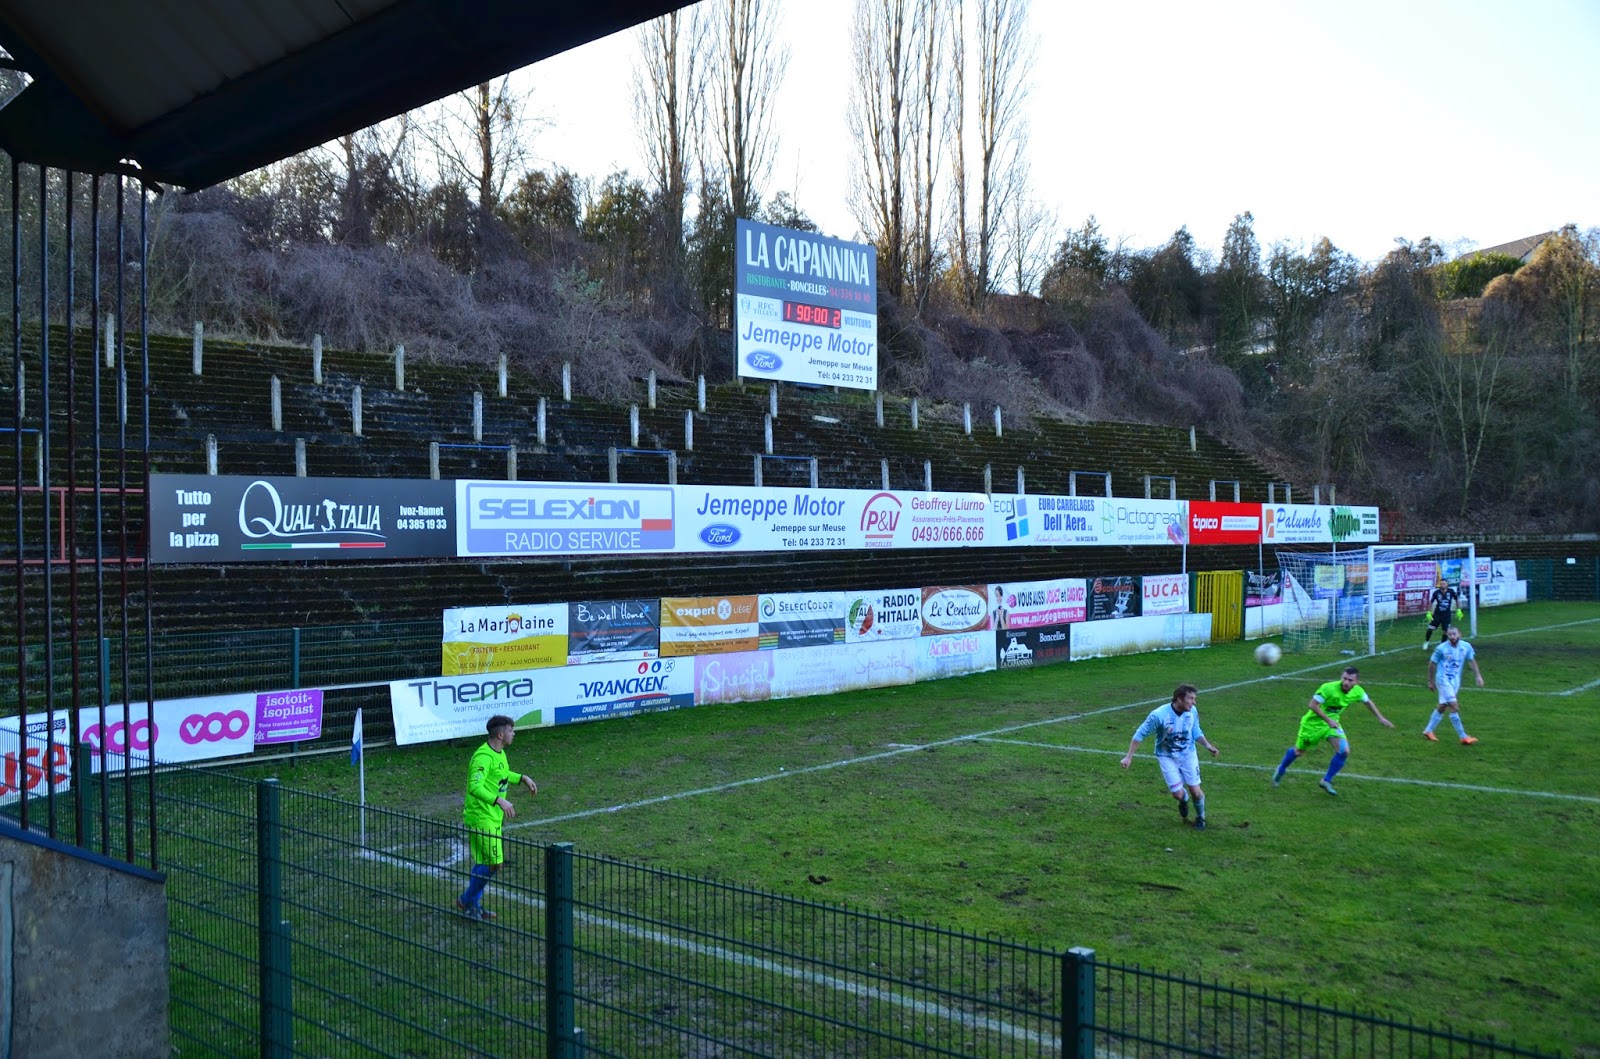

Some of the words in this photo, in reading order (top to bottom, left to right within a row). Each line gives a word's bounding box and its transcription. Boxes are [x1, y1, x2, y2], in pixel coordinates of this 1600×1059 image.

[746, 229, 770, 269] LA
[774, 235, 870, 286] CAPANNINA
[746, 273, 787, 290] RISTORANTE
[790, 279, 827, 296] BONCELLES
[796, 304, 828, 325] 90:00
[833, 310, 841, 328] 2
[844, 316, 872, 329] VISITEURS
[742, 321, 823, 353] Jemeppe
[827, 332, 874, 357] Motor
[752, 352, 775, 369] Ford
[808, 357, 839, 369] Jemeppe
[840, 361, 851, 369] sur
[852, 362, 873, 372] Meuse
[831, 372, 840, 380] 04
[841, 372, 854, 382] 233
[856, 374, 864, 383] 72
[865, 375, 873, 384] 31
[175, 489, 212, 505] Tutto
[911, 497, 952, 514] Geoffrey
[955, 498, 985, 511] Liurno
[1038, 498, 1056, 511] EURO
[1056, 499, 1095, 512] CARRELAGES
[399, 505, 444, 516] Ivoz-Ramet
[697, 493, 787, 522] Jemeppe
[793, 494, 846, 516] Motor
[993, 500, 1012, 513] ECD
[182, 513, 207, 527] per
[397, 518, 408, 530] 04
[408, 518, 425, 530] 385
[425, 518, 435, 530] 19
[436, 518, 447, 530] 33
[866, 510, 900, 532] P&V
[1043, 513, 1062, 531] Dell
[1117, 507, 1182, 530] Pictogram
[1192, 514, 1219, 532] tipico
[1276, 507, 1322, 529] Palumbo
[707, 528, 733, 544] Ford
[771, 523, 806, 534] Jemeppe
[822, 524, 846, 532] Meuse
[911, 526, 984, 543] 0493/666.666
[169, 531, 184, 547] la
[185, 531, 219, 548] pizza
[505, 532, 562, 550] RADIO
[568, 531, 641, 549] SERVICE
[799, 538, 809, 546] 04
[810, 538, 824, 546] 233
[826, 538, 835, 546] 72
[836, 537, 846, 546] 31
[1144, 582, 1187, 599] LUCAS
[883, 594, 915, 608] RADIO
[1017, 592, 1033, 607] VOUS
[577, 604, 595, 622] Be
[620, 602, 645, 620] Home
[675, 605, 716, 618] expert
[877, 609, 919, 623] HITALIA
[929, 601, 942, 618] Le
[946, 600, 981, 617] Central
[460, 620, 475, 634] La
[478, 614, 554, 635] Marjolaine
[1039, 630, 1066, 643] Boncelles
[503, 643, 540, 653] RESTAURANT
[408, 678, 533, 708] Thema
[579, 675, 669, 698] VRANCKEN
[266, 693, 312, 707] isotoit-
[453, 703, 482, 713] warmly
[482, 698, 534, 711] recommended
[582, 704, 608, 713] CHAUFFAGE
[613, 701, 636, 710] SANITAIRE
[262, 703, 314, 720] isoplast
